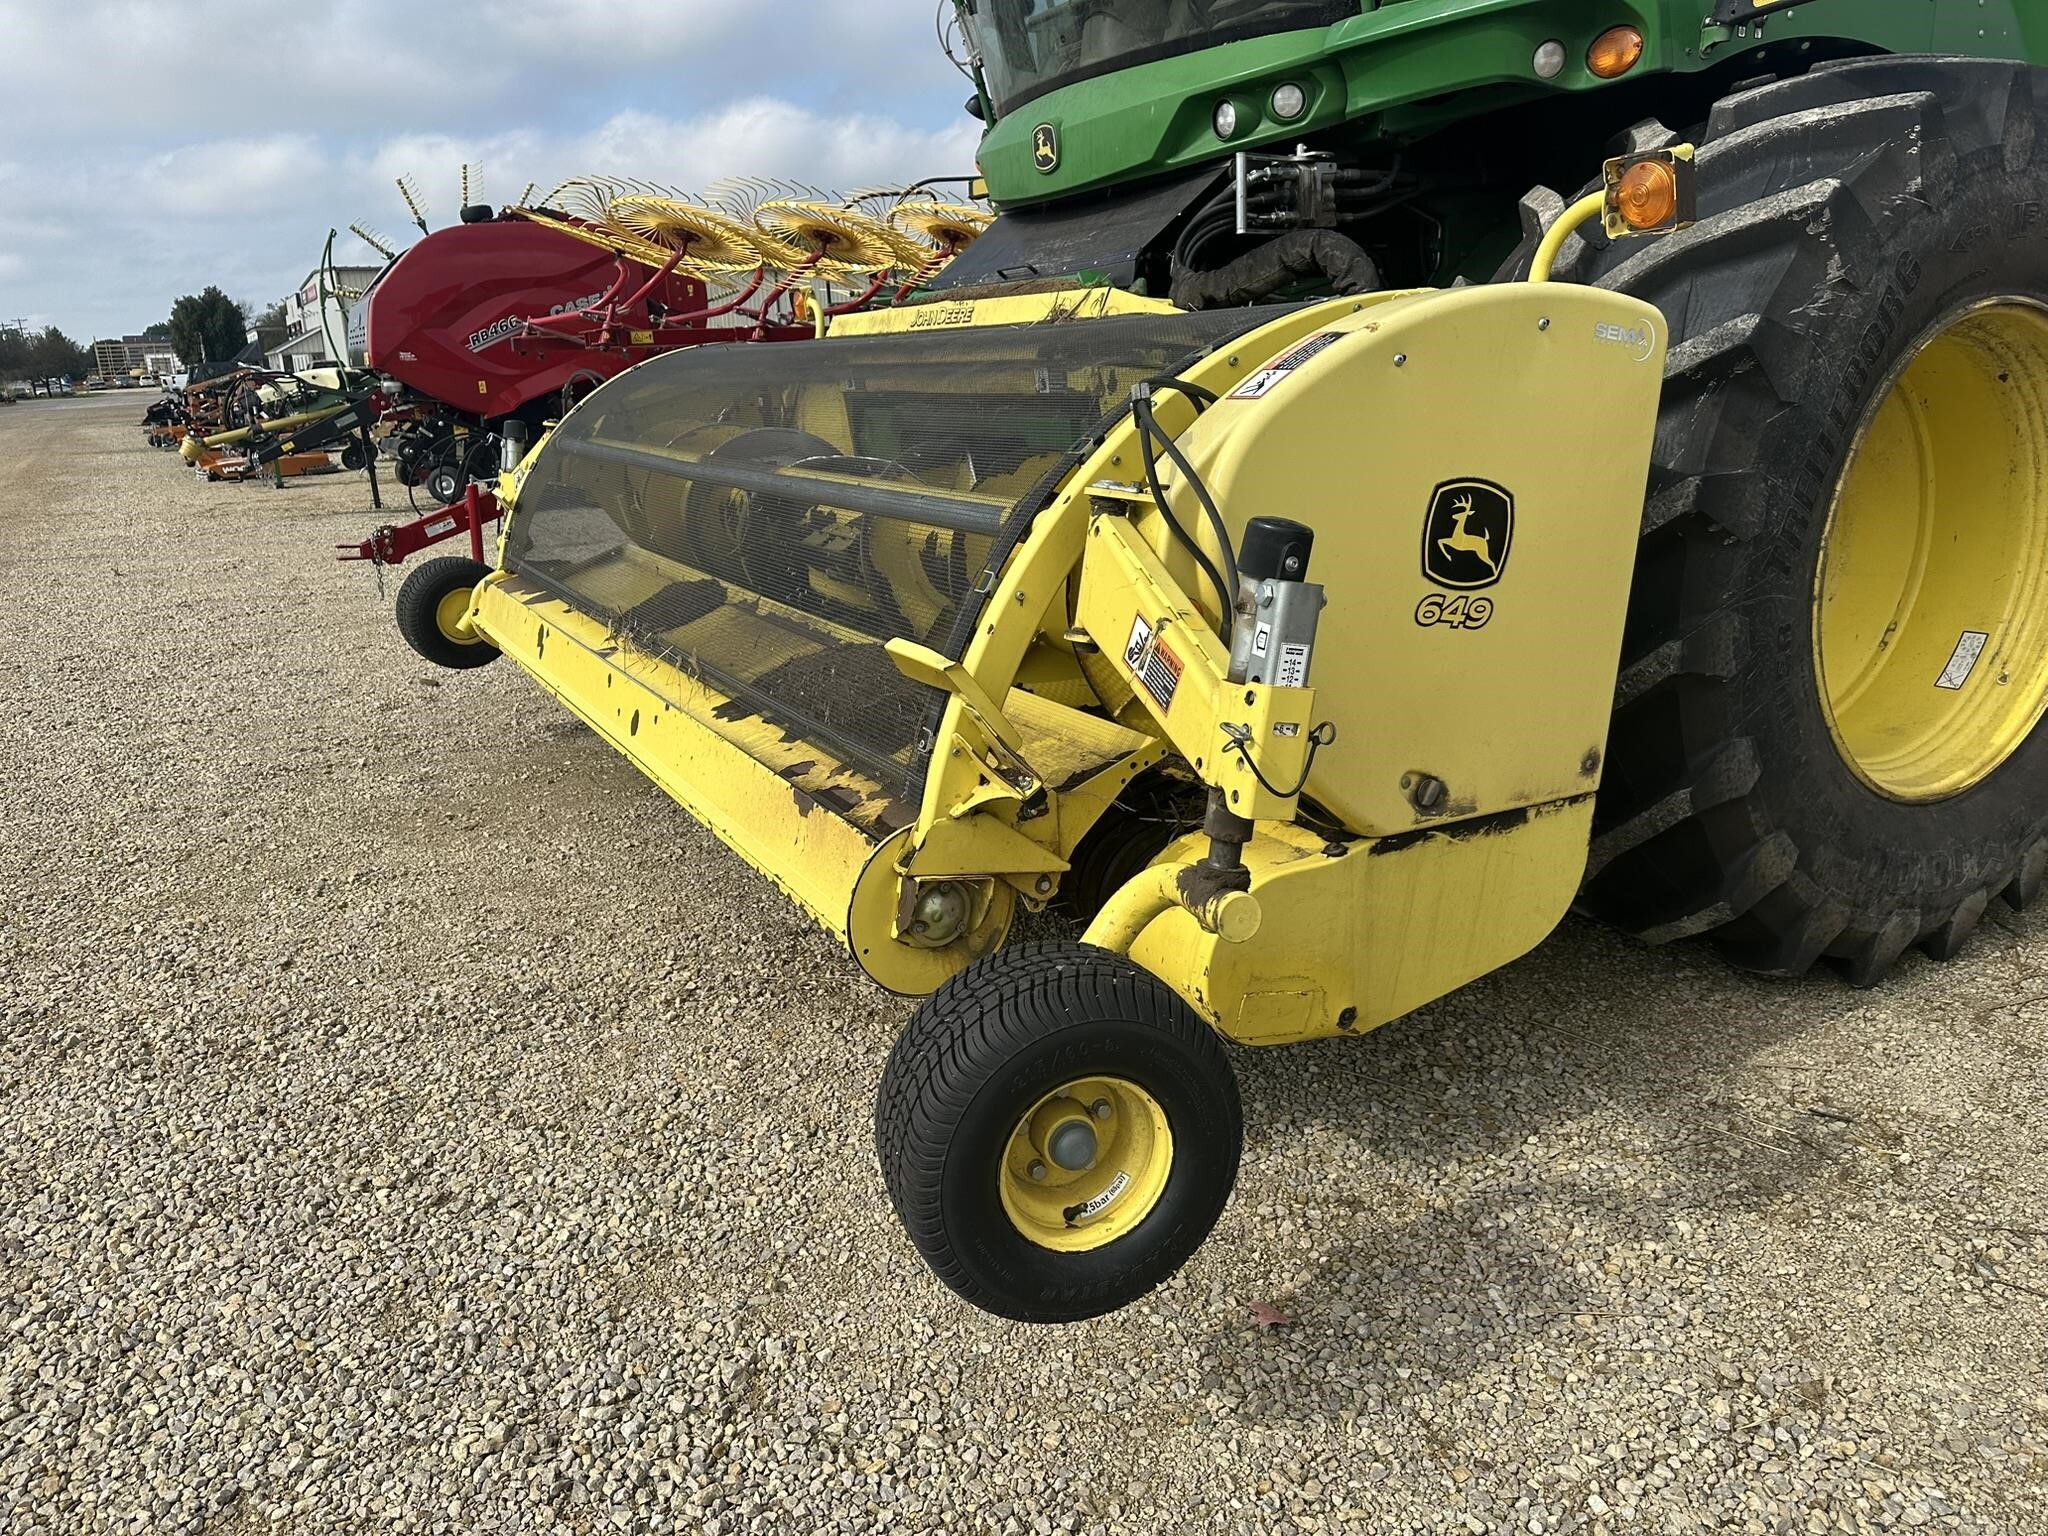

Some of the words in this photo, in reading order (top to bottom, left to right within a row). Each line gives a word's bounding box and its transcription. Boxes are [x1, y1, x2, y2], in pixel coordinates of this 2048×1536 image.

[910, 308, 937, 327] JOHN
[937, 306, 974, 326] DEERE
[1414, 593, 1494, 630] 649
